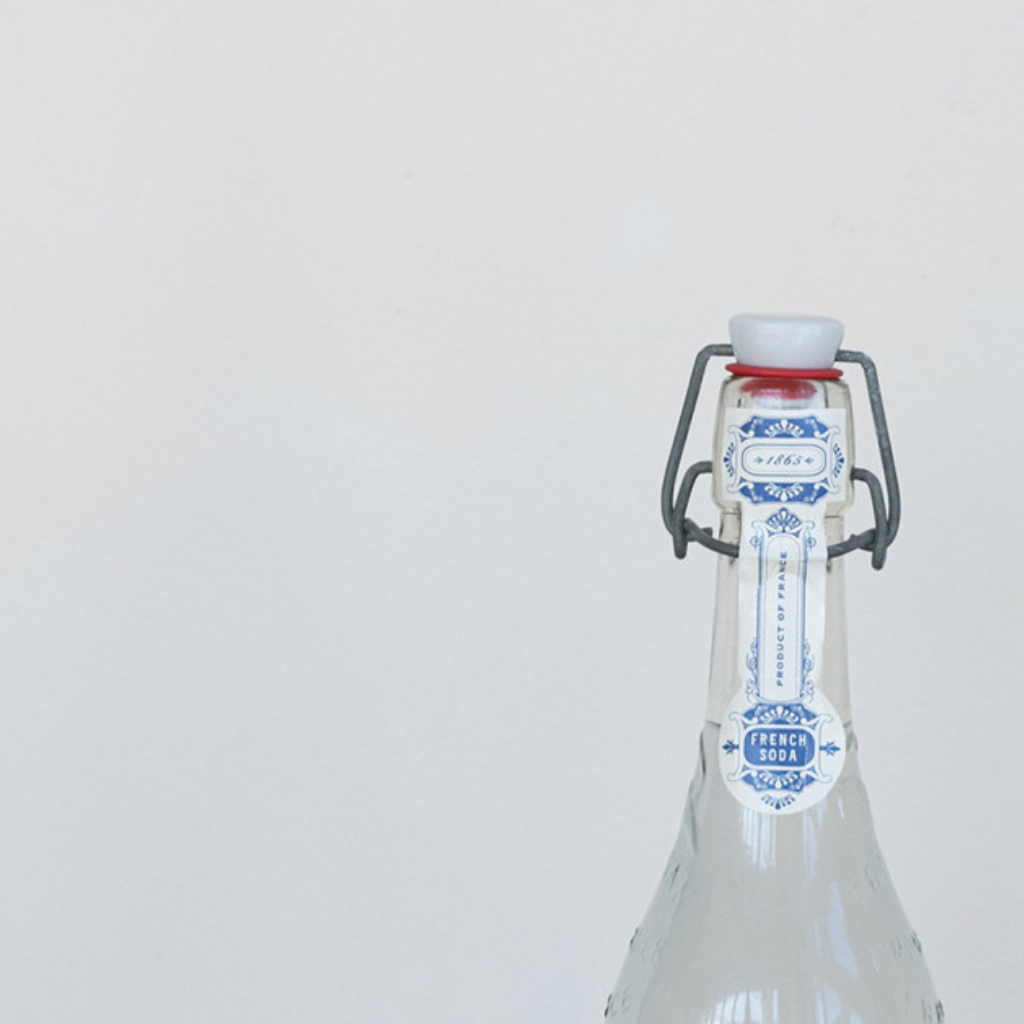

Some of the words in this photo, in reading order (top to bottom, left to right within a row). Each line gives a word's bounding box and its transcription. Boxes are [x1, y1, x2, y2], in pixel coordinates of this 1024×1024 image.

[765, 453, 803, 467] 1865
[777, 551, 788, 600] FRANCE
[776, 604, 786, 621] OF
[776, 626, 786, 687] PRODUCT
[750, 732, 807, 747] FRENCH
[759, 748, 798, 763] SODA
